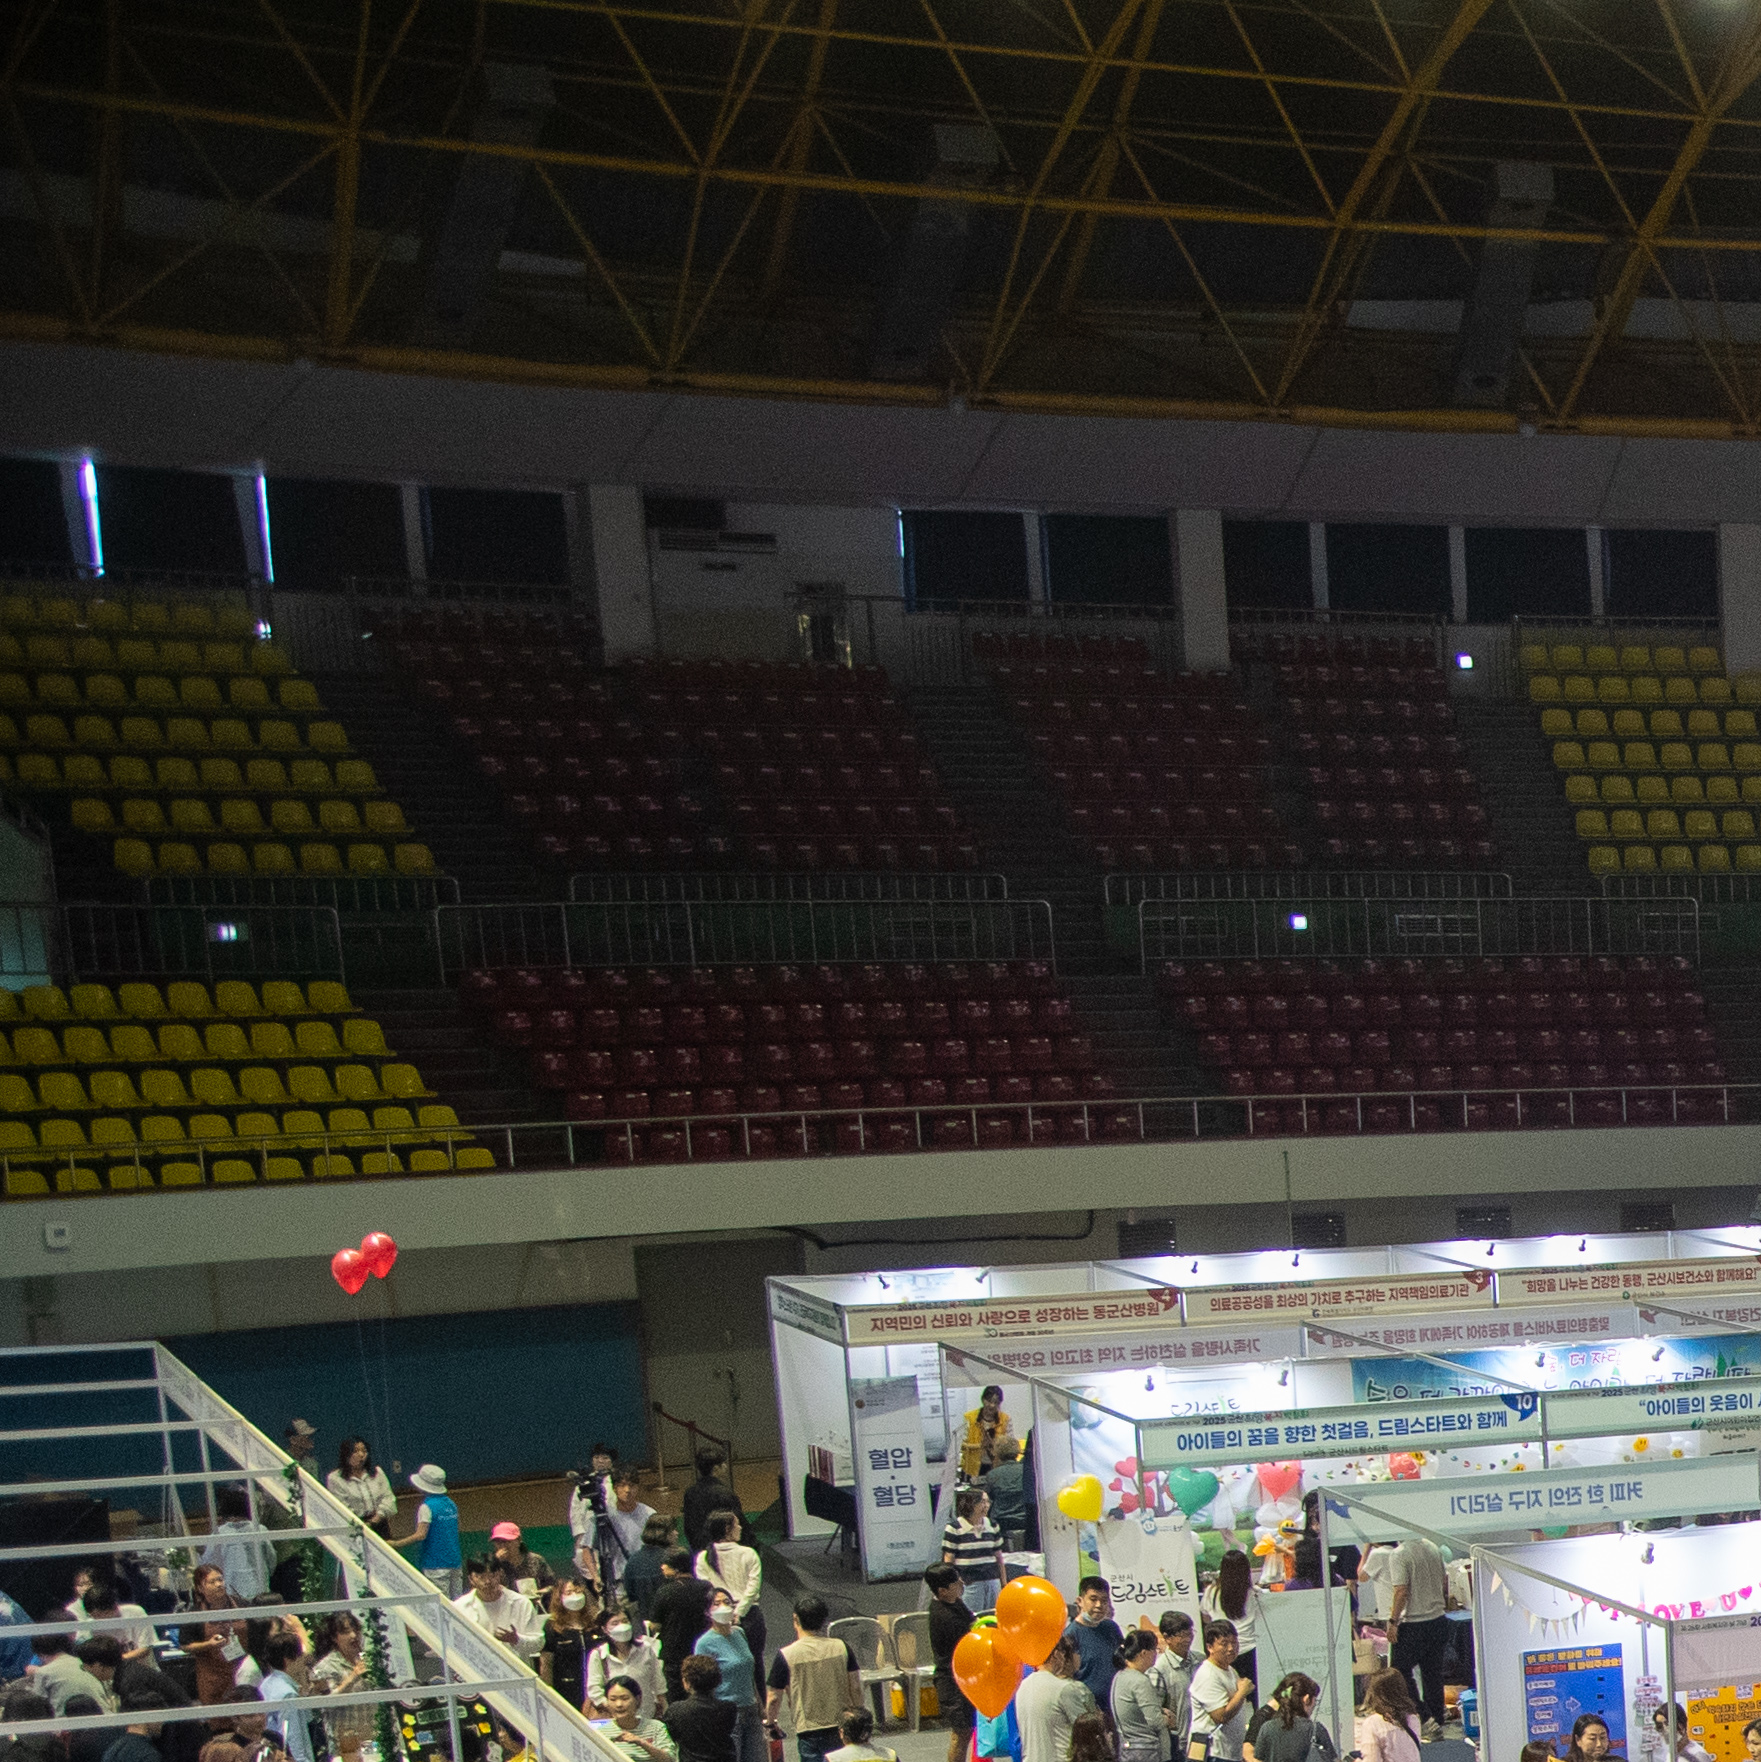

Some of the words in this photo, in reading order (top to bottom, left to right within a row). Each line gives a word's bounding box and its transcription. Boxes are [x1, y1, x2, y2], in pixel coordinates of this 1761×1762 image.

[1559, 1277, 1588, 1291] 나누는
[1591, 1275, 1620, 1289] 건강한
[1647, 1270, 1714, 1286] 군산시보건소와
[1210, 1294, 1273, 1312] 의료공공성을
[1277, 1291, 1308, 1308] 최상의
[1312, 1290, 1342, 1306] 가치로
[1345, 1288, 1386, 1304] 추구하는
[1389, 1283, 1469, 1301] 지역책임의료기관
[870, 1315, 927, 1333] 지역민의
[931, 1313, 972, 1330] 신뢰와
[977, 1310, 1031, 1327] 사랑으로
[1035, 1306, 1089, 1323] 성장하는
[1093, 1302, 1160, 1320] 동군산병원
[1710, 1392, 1753, 1412] 웃음이
[1177, 1431, 1242, 1451] 아이들의
[1247, 1428, 1279, 1447] 꿈을
[1284, 1425, 1316, 1444] 향한
[1321, 1422, 1374, 1443] 첫걸음,
[1378, 1415, 1472, 1436] 드림스타트와
[1477, 1411, 1507, 1429] 함께
[868, 1447, 913, 1471] 혈압
[873, 1484, 917, 1508] 혈당
[1720, 1591, 1738, 1612] U
